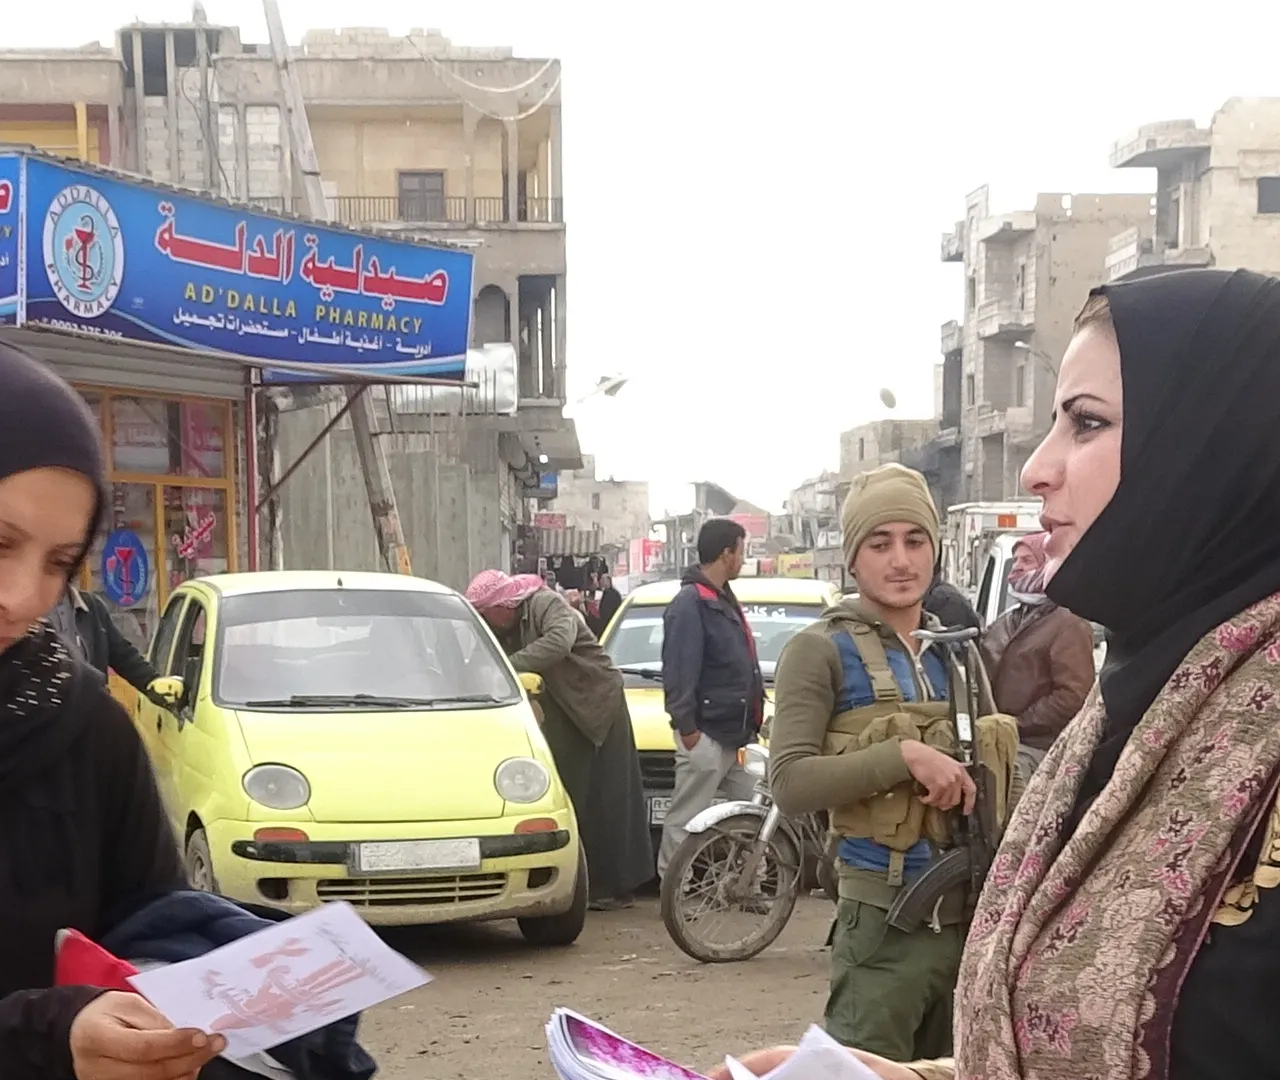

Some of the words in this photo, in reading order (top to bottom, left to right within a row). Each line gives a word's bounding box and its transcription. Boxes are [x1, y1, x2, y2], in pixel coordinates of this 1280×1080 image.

[154, 200, 295, 286] الدلة
[299, 232, 450, 312] صيدلية
[47, 262, 119, 314] PHARMACY
[173, 306, 226, 331] تجميل
[184, 281, 297, 318] AD'DALLA
[315, 304, 423, 334] PHARMACY
[226, 312, 289, 337] مستحضرات
[298, 326, 345, 345] أطفال
[345, 330, 382, 352] أغذية
[395, 337, 432, 358] أدوية
